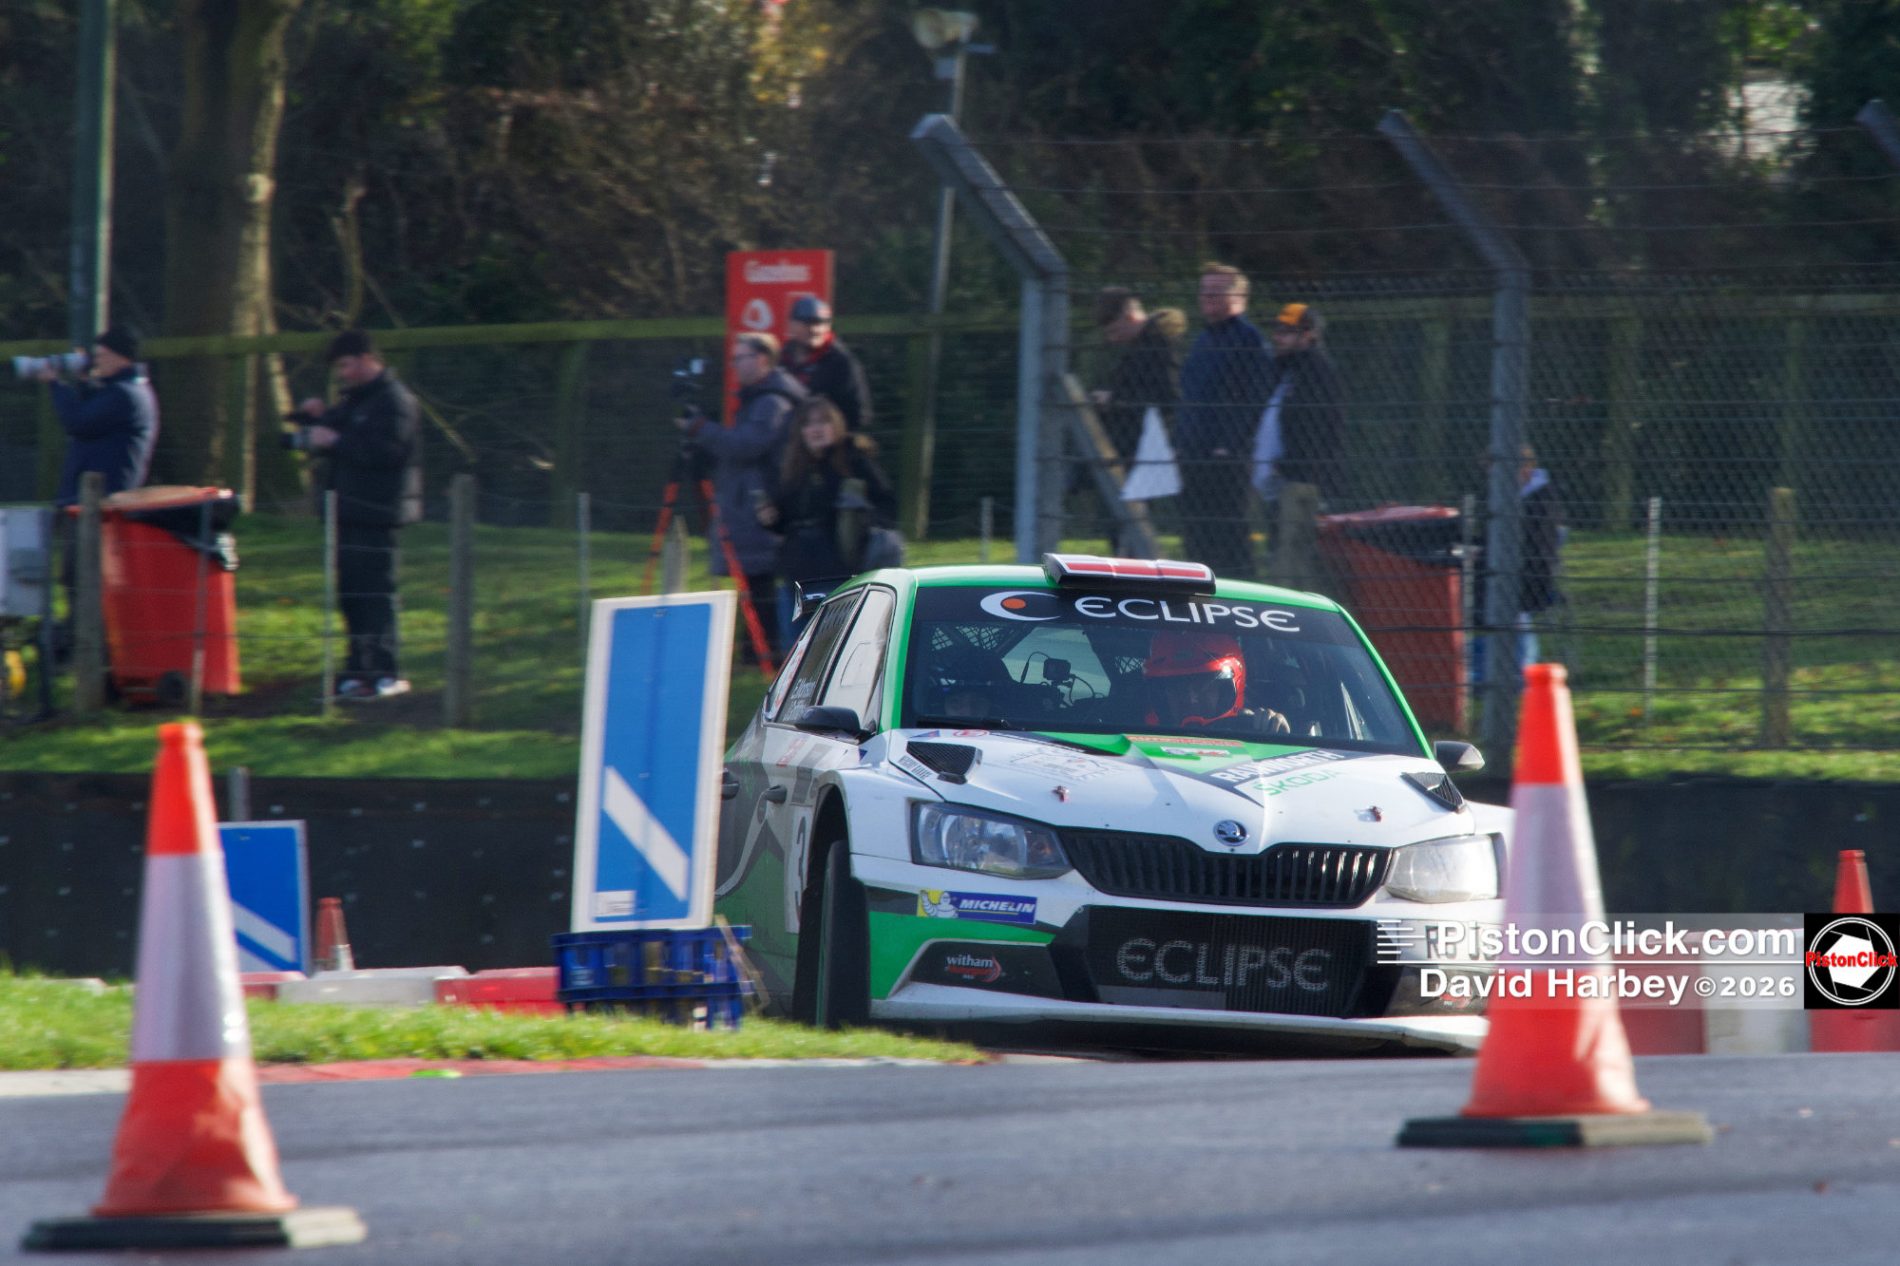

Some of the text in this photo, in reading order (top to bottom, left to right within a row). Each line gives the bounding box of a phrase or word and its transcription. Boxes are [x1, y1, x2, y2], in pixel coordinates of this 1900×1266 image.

[1075, 597, 1300, 632] ECLIPSE
[959, 899, 1036, 913] MICHELIN
[946, 954, 993, 968] witham
[1117, 938, 1331, 991] ECLIPSE
